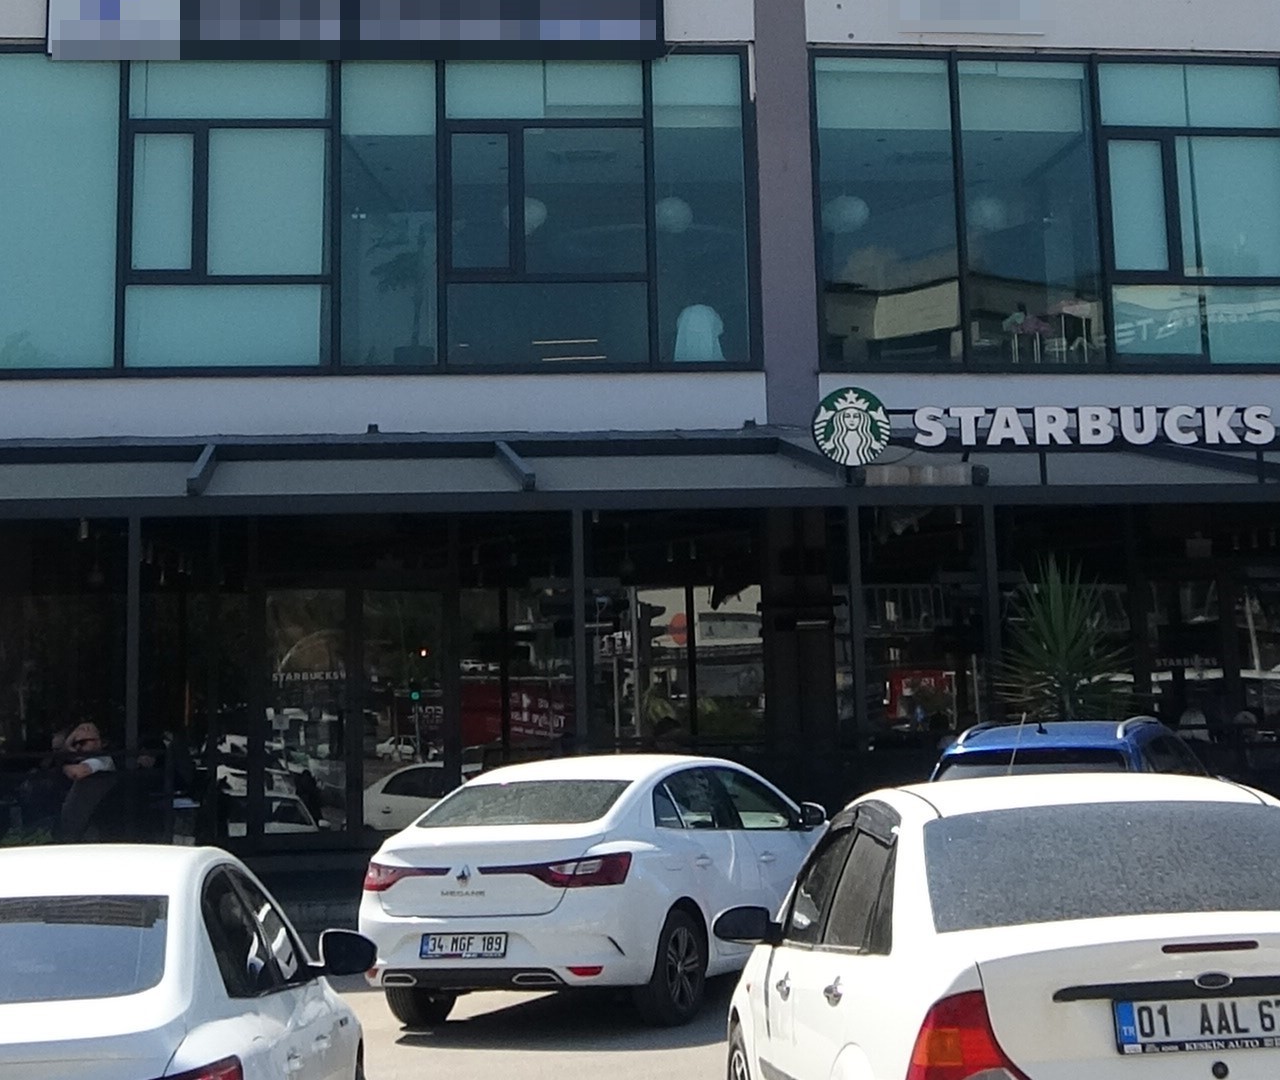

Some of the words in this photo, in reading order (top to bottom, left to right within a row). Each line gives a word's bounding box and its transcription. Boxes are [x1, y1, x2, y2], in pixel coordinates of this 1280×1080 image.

[913, 405, 1277, 447] STARBUCKS
[429, 937, 444, 952] 34
[482, 936, 502, 952] 189
[1137, 1004, 1172, 1038] 01
[1199, 1002, 1250, 1036] AAL
